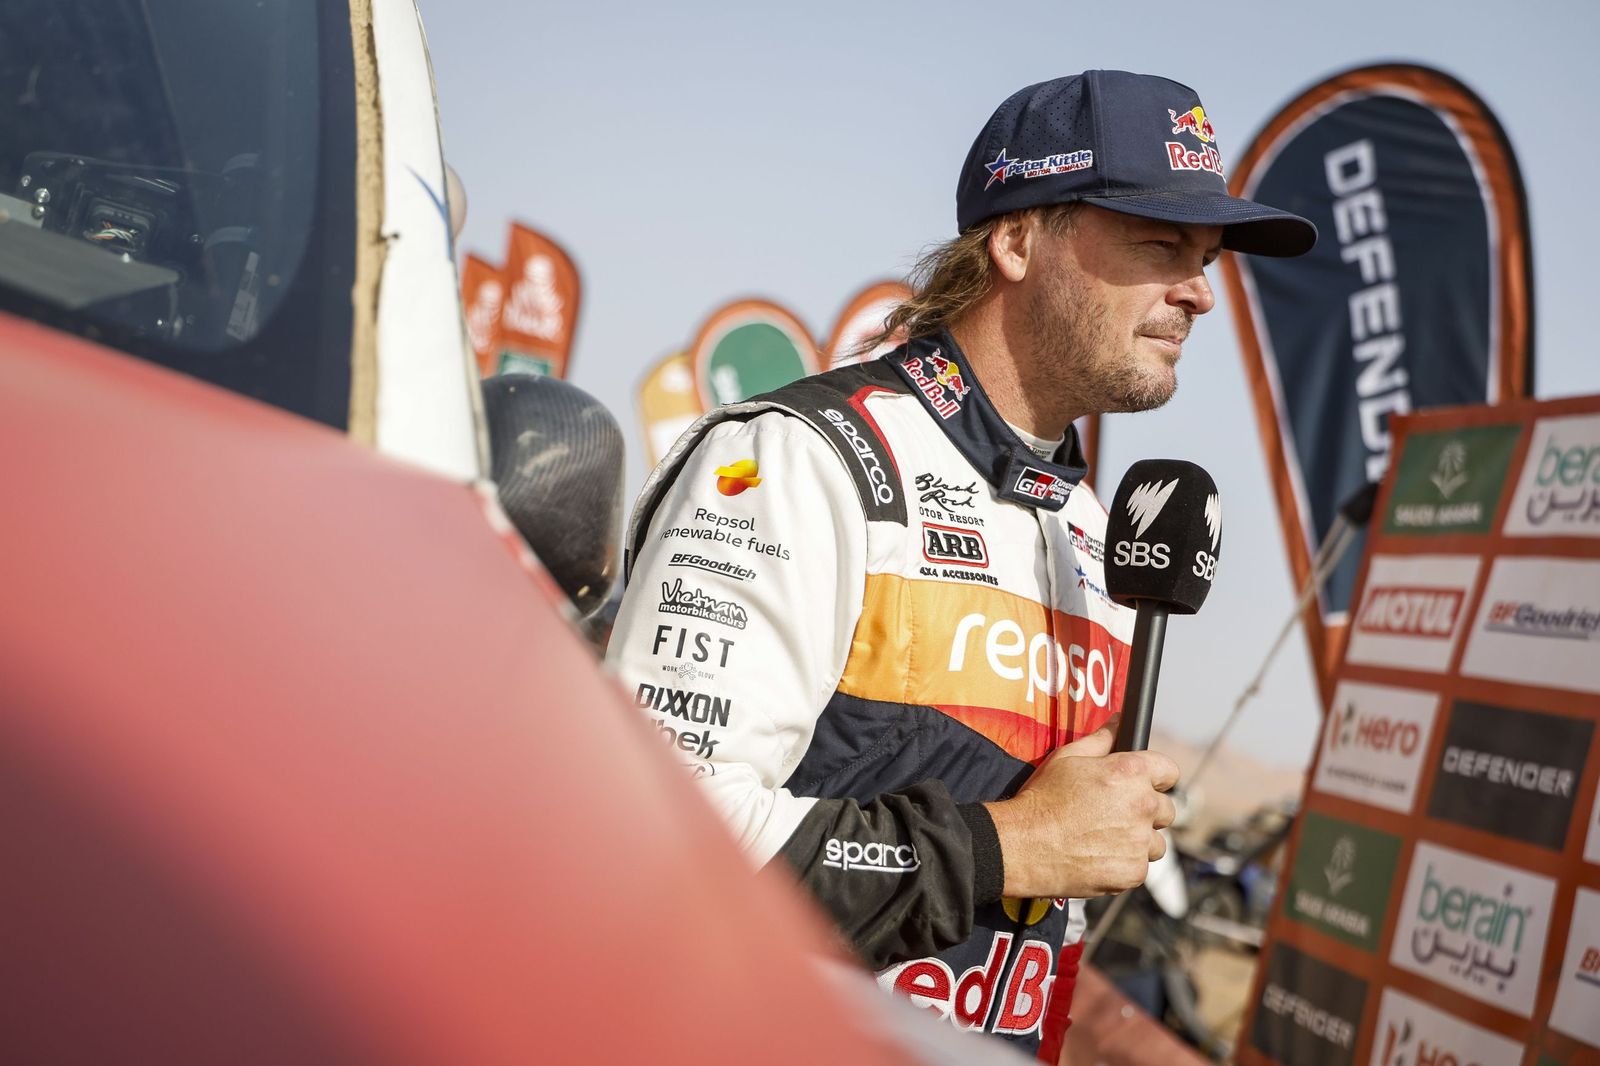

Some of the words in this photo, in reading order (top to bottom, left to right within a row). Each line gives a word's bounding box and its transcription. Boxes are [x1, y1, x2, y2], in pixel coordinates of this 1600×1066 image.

[1007, 160, 1047, 176] Peter
[1048, 151, 1092, 168] Kittle
[1165, 141, 1215, 173] Red
[1324, 139, 1412, 482] DEFEND
[901, 357, 937, 390] Red
[922, 382, 961, 419] Bull
[822, 408, 894, 504] sparco
[915, 472, 980, 495] Black
[1018, 478, 1048, 497] GR
[920, 489, 976, 513] Rock
[695, 508, 755, 531] Repsol
[919, 506, 944, 521] OTOR
[948, 513, 985, 528] RESORT
[747, 537, 790, 560] fuels
[927, 530, 983, 560] ARB
[1113, 540, 1171, 570] SBS
[670, 553, 757, 580] BFGoodrich
[942, 568, 999, 586] ACCESSORIES
[662, 578, 747, 620] Vietnam
[1361, 590, 1457, 635] MOTUL
[660, 603, 746, 629] motorbiketours
[652, 625, 735, 668] FIST
[948, 613, 1114, 711] repsol
[662, 665, 678, 673] WORK
[635, 683, 732, 727] DIXXON
[1355, 713, 1420, 758] Hero
[1443, 745, 1576, 798] DEFENDER
[1418, 863, 1528, 955] berain
[1264, 983, 1355, 1049] DEFENDER
